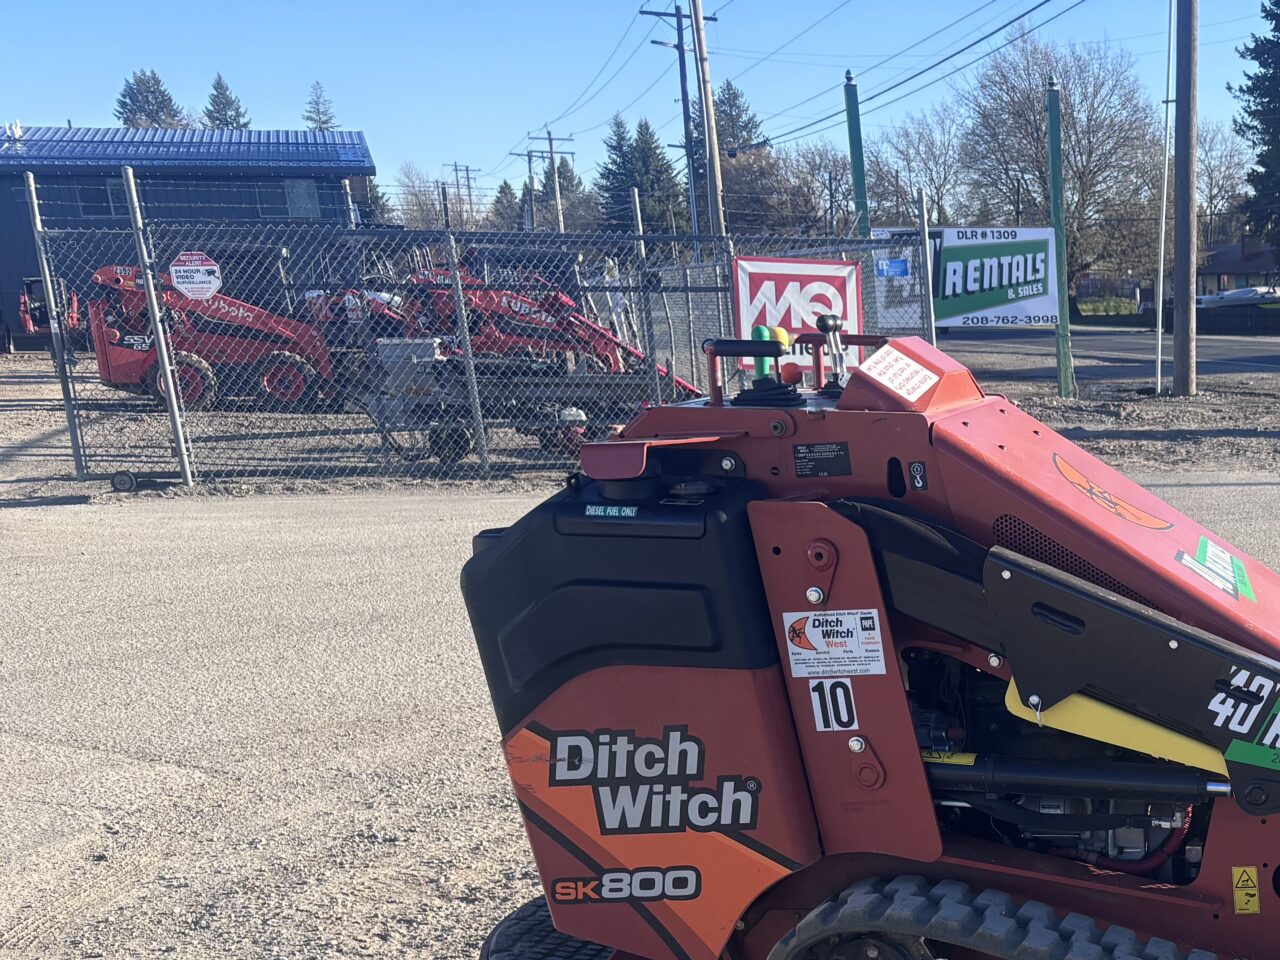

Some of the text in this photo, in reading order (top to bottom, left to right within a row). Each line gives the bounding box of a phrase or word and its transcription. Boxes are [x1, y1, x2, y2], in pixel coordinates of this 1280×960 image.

[957, 230, 1017, 240] DLR # 1309
[945, 252, 1045, 296] RENTALS
[1008, 284, 1043, 299] & SALES
[962, 316, 1058, 325] 208-762-3998
[586, 505, 638, 517] DIESEL FUEL ONLY
[813, 618, 842, 628] Ditch
[822, 628, 853, 639] Witch
[812, 681, 855, 728] 10
[555, 732, 699, 780] Ditch
[555, 870, 697, 900] SK800
